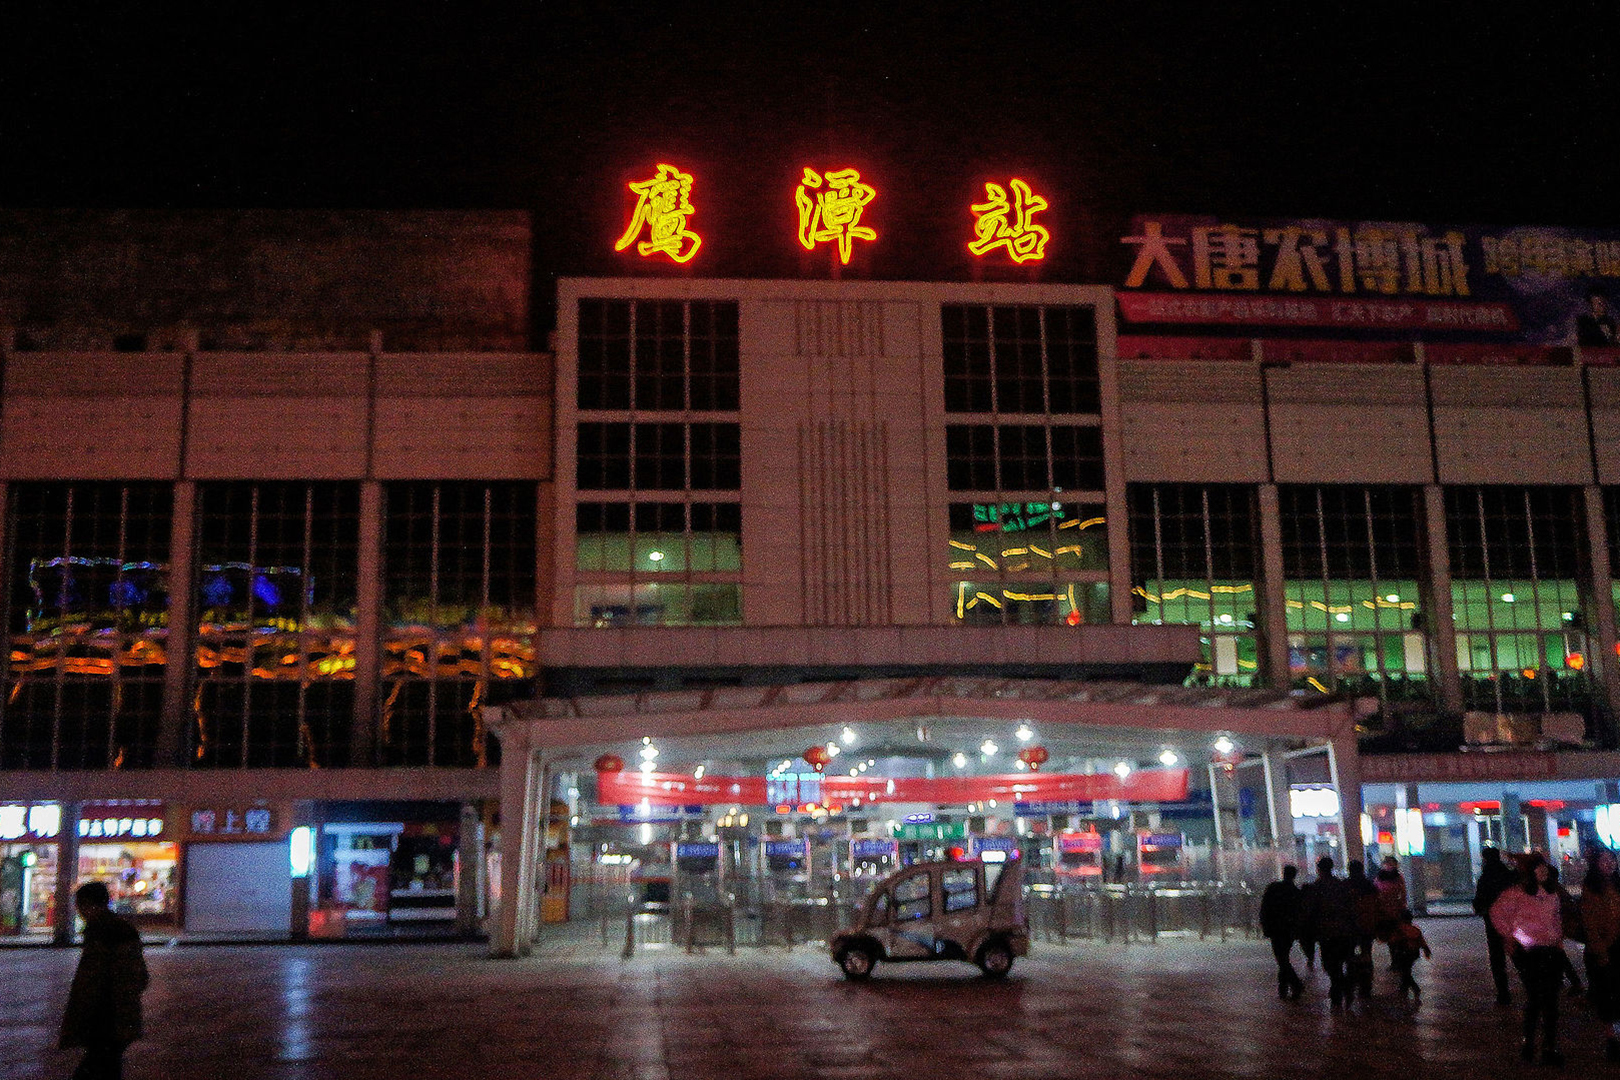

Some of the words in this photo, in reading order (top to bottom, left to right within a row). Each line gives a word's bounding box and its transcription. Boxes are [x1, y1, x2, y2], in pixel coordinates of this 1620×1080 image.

[614, 163, 1051, 264] 鹰潭站
[1119, 221, 1471, 296] 大唐农博城
